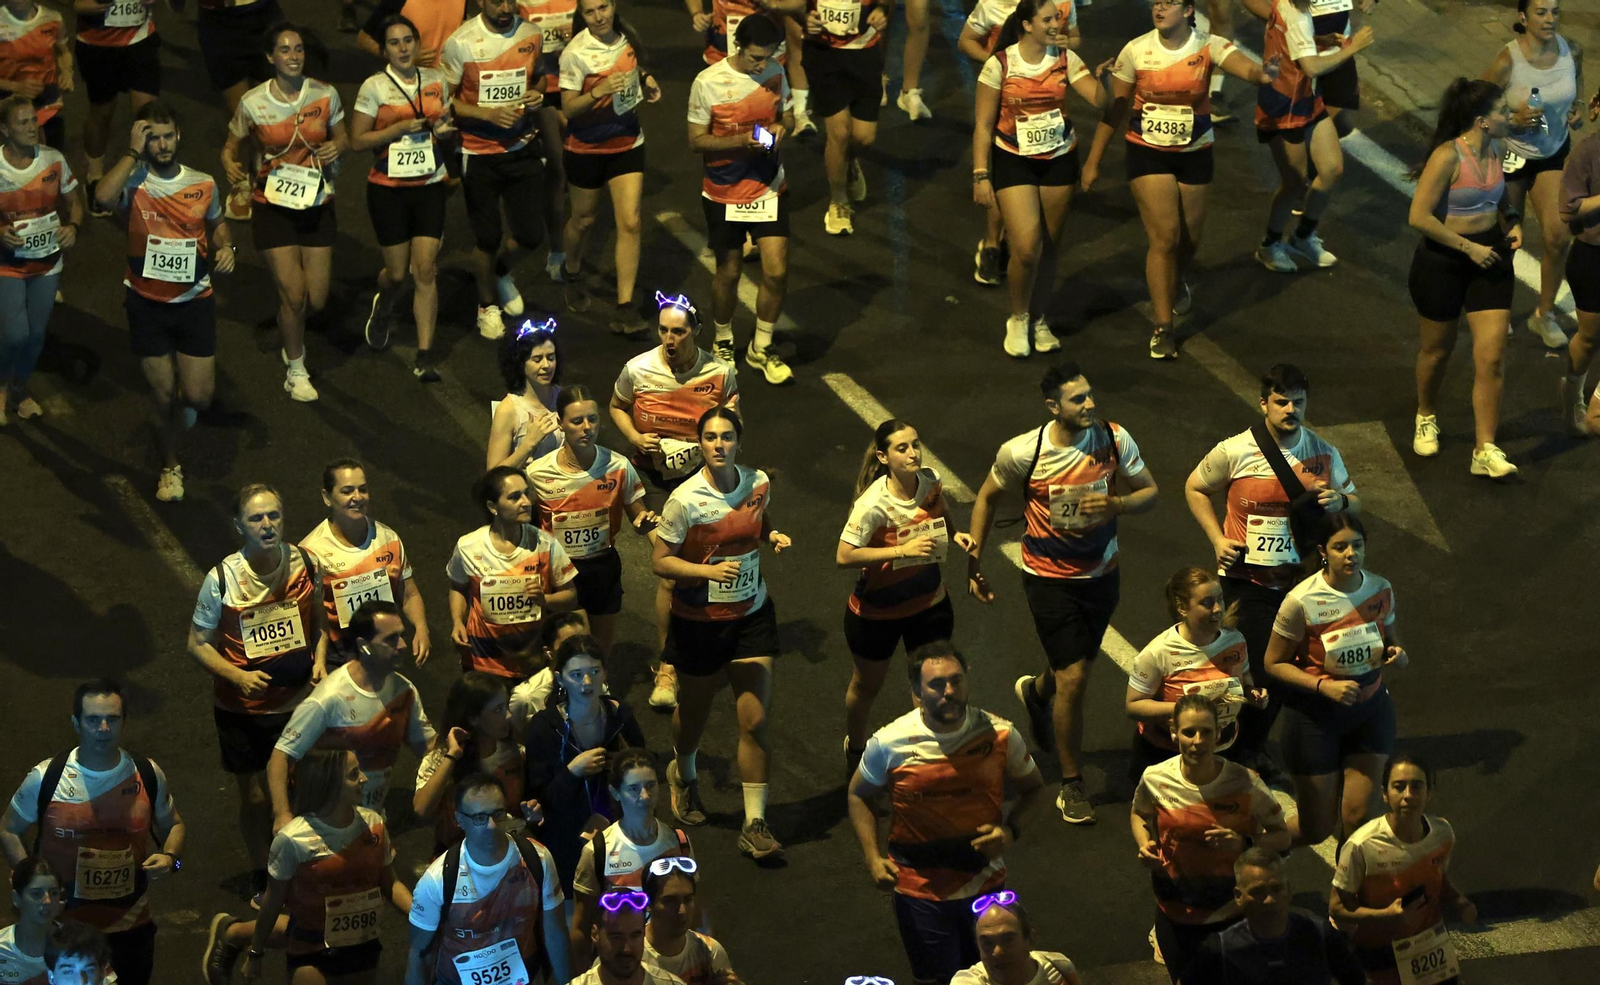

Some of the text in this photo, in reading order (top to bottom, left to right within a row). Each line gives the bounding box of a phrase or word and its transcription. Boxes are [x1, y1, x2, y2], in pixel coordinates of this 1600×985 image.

[110, 2, 146, 16] 21682
[822, 8, 855, 24] 18451
[485, 85, 521, 100] 12984
[1026, 127, 1056, 144] 9079
[1147, 120, 1186, 135] 24383
[397, 150, 426, 165] 2729
[275, 179, 307, 198] 2721
[26, 231, 53, 250] 5697
[151, 253, 189, 270] 13491
[564, 527, 600, 544] 8736
[1257, 536, 1292, 552] 2724
[488, 595, 533, 611] 10854
[249, 619, 295, 644] 10851
[1336, 645, 1373, 665] 4881
[83, 867, 130, 887] 16279
[331, 911, 377, 932] 23698
[1411, 947, 1446, 975] 8202
[471, 960, 511, 985] 9525
